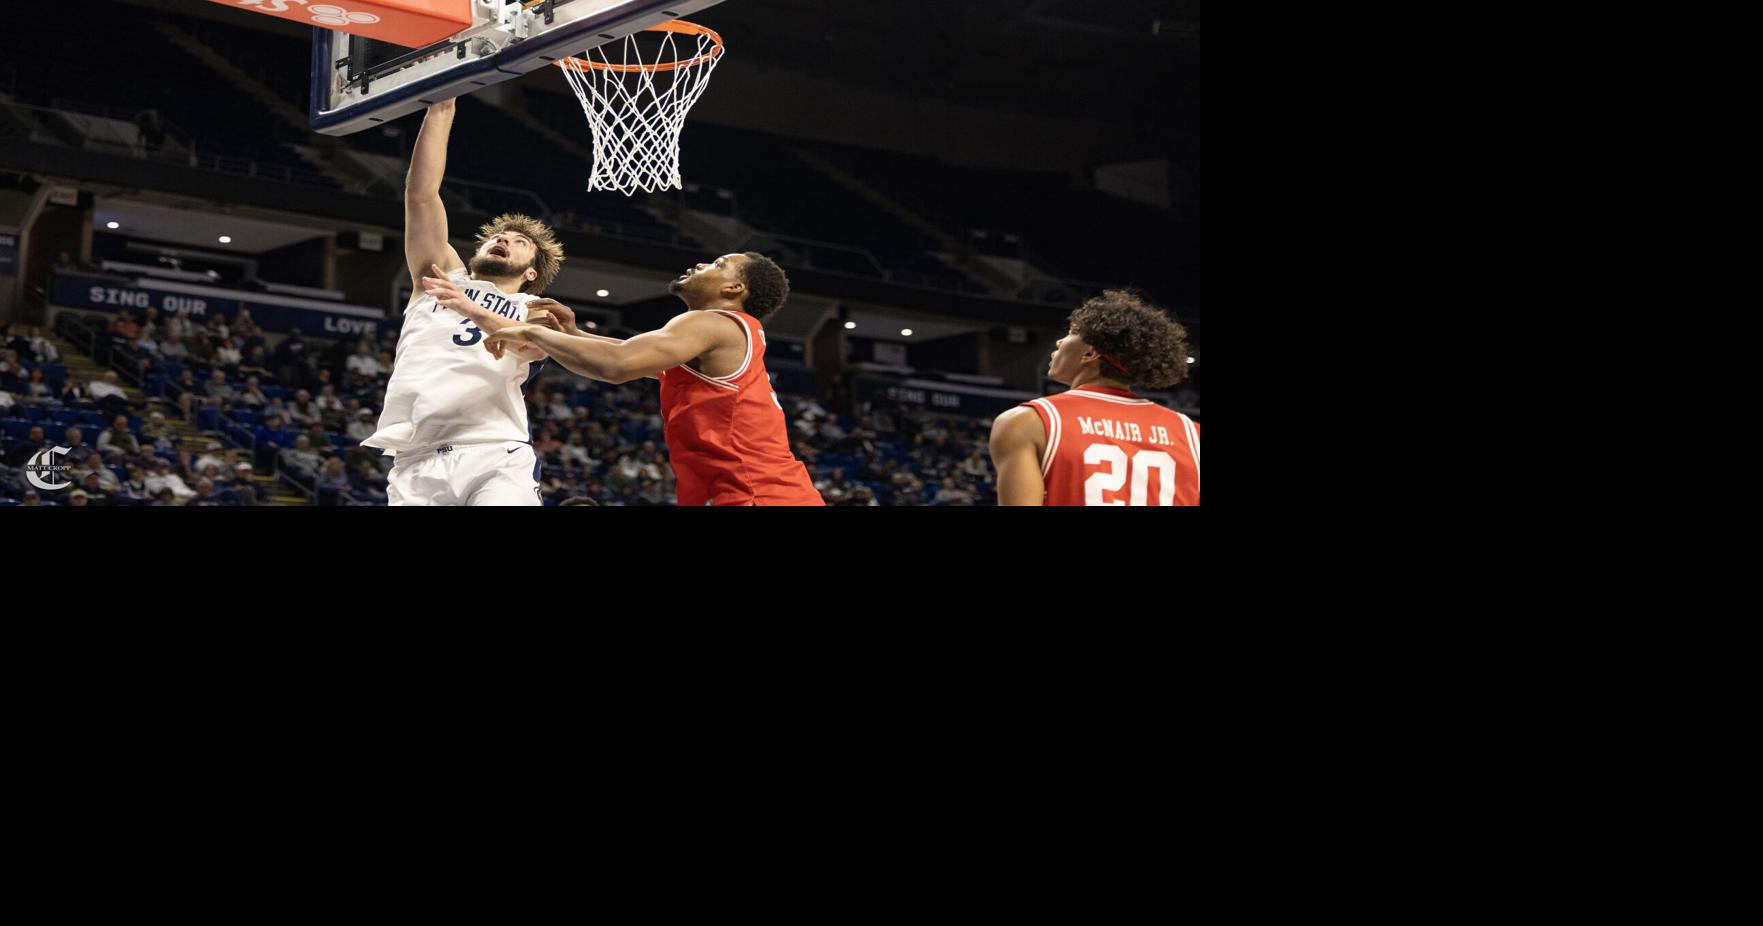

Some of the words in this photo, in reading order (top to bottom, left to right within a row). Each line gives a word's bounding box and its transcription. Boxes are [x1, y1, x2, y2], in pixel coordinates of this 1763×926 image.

[90, 286, 149, 308] SING
[163, 295, 207, 315] OUR
[324, 316, 377, 335] LOVE
[1149, 425, 1174, 446] JR.
[1083, 443, 1176, 506] 20
